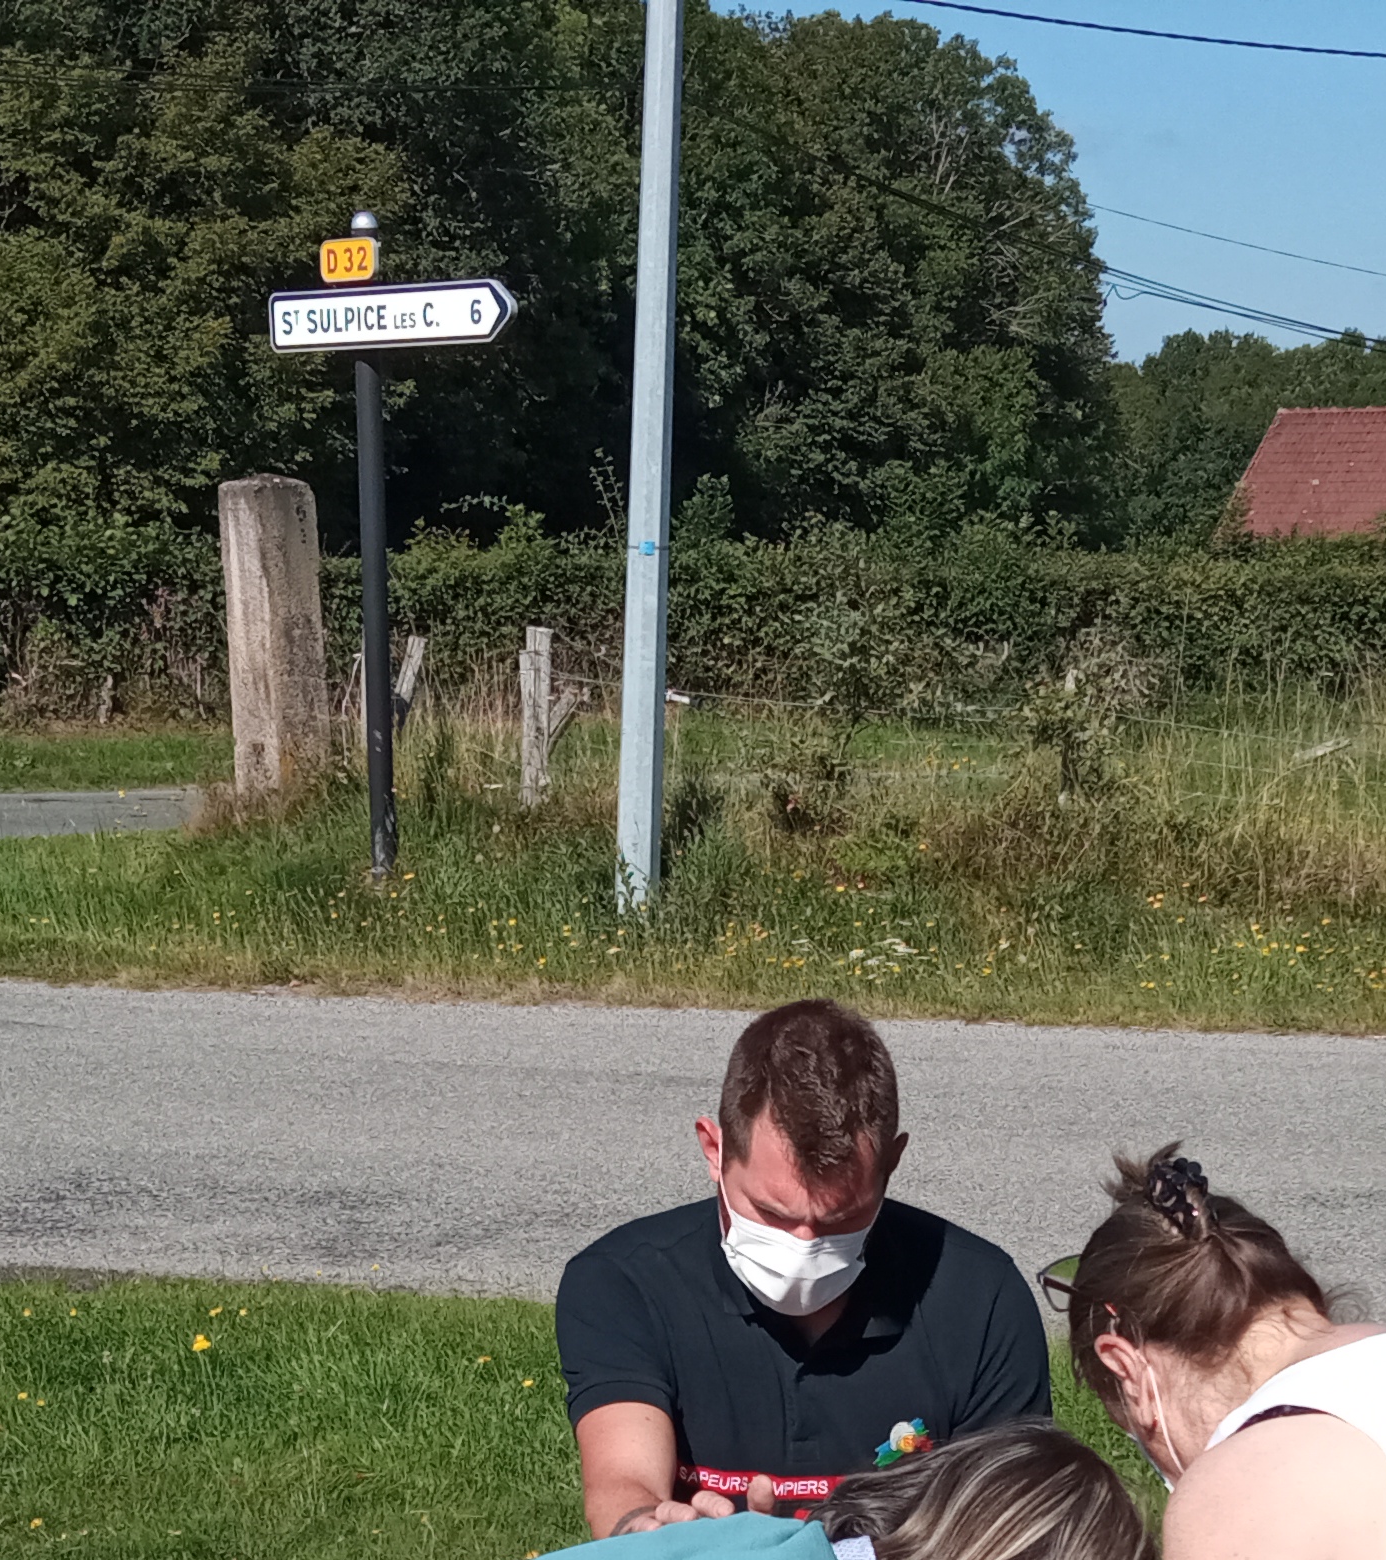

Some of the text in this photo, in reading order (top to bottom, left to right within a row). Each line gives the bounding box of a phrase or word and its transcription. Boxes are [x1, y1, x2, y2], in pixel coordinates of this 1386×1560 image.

[306, 304, 387, 334] SULPICE
[393, 312, 416, 330] LES
[422, 302, 440, 327] C.
[470, 299, 482, 324] 6
